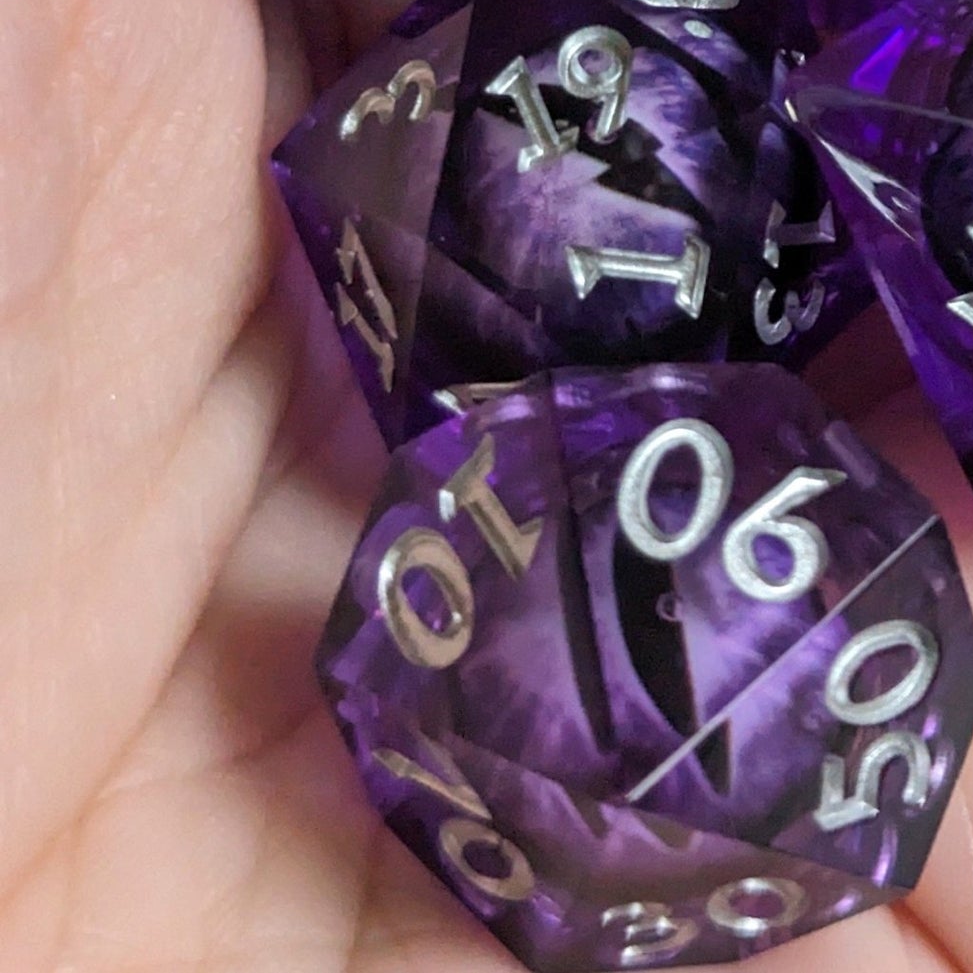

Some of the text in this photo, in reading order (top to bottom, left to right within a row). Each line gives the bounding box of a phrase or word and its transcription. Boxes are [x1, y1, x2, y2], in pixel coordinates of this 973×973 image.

[340, 60, 436, 141] 3
[486, 25, 634, 172] 19
[566, 233, 710, 319] 1
[813, 620, 941, 831] 50
[602, 877, 807, 966] 30
